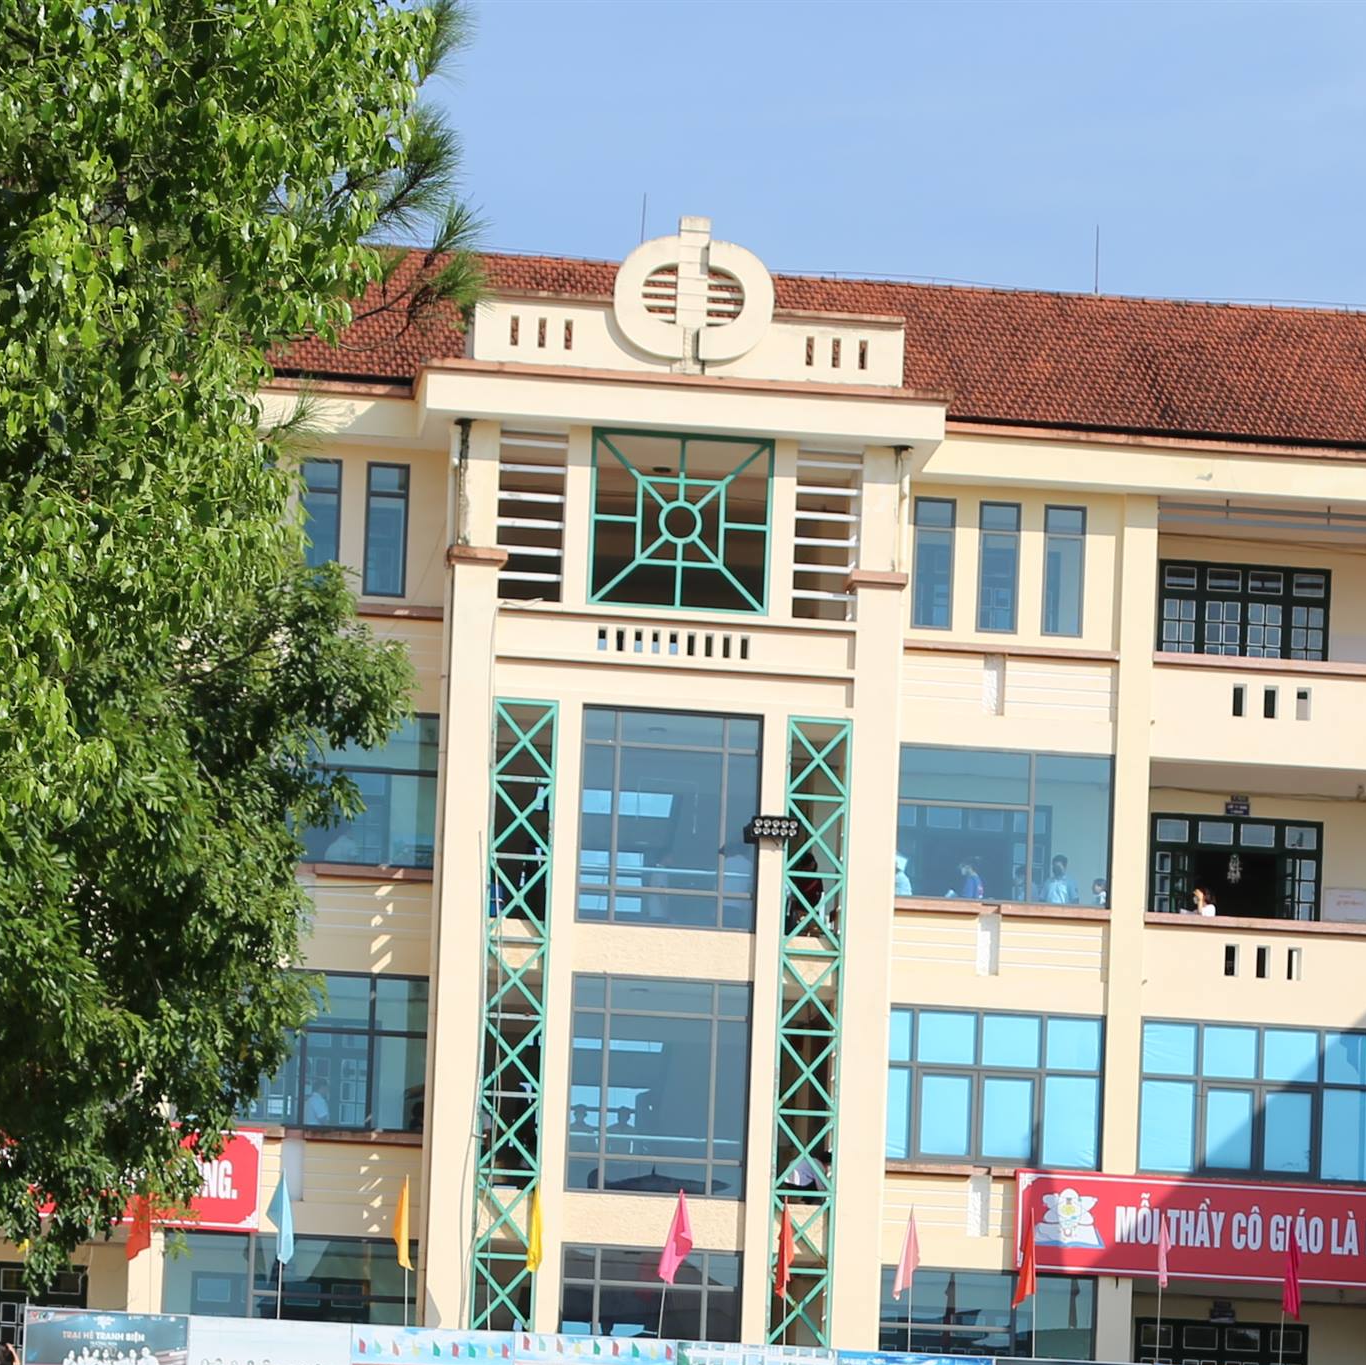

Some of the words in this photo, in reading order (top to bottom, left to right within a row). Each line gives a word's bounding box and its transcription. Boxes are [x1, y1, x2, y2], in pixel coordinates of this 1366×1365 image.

[1114, 1192, 1160, 1245] MỖI
[1166, 1198, 1225, 1248] THẦY
[1231, 1205, 1263, 1251] CÔ
[1270, 1208, 1324, 1254] GIÁO
[1330, 1211, 1359, 1256] LÀ
[95, 1332, 124, 1342] TRANH
